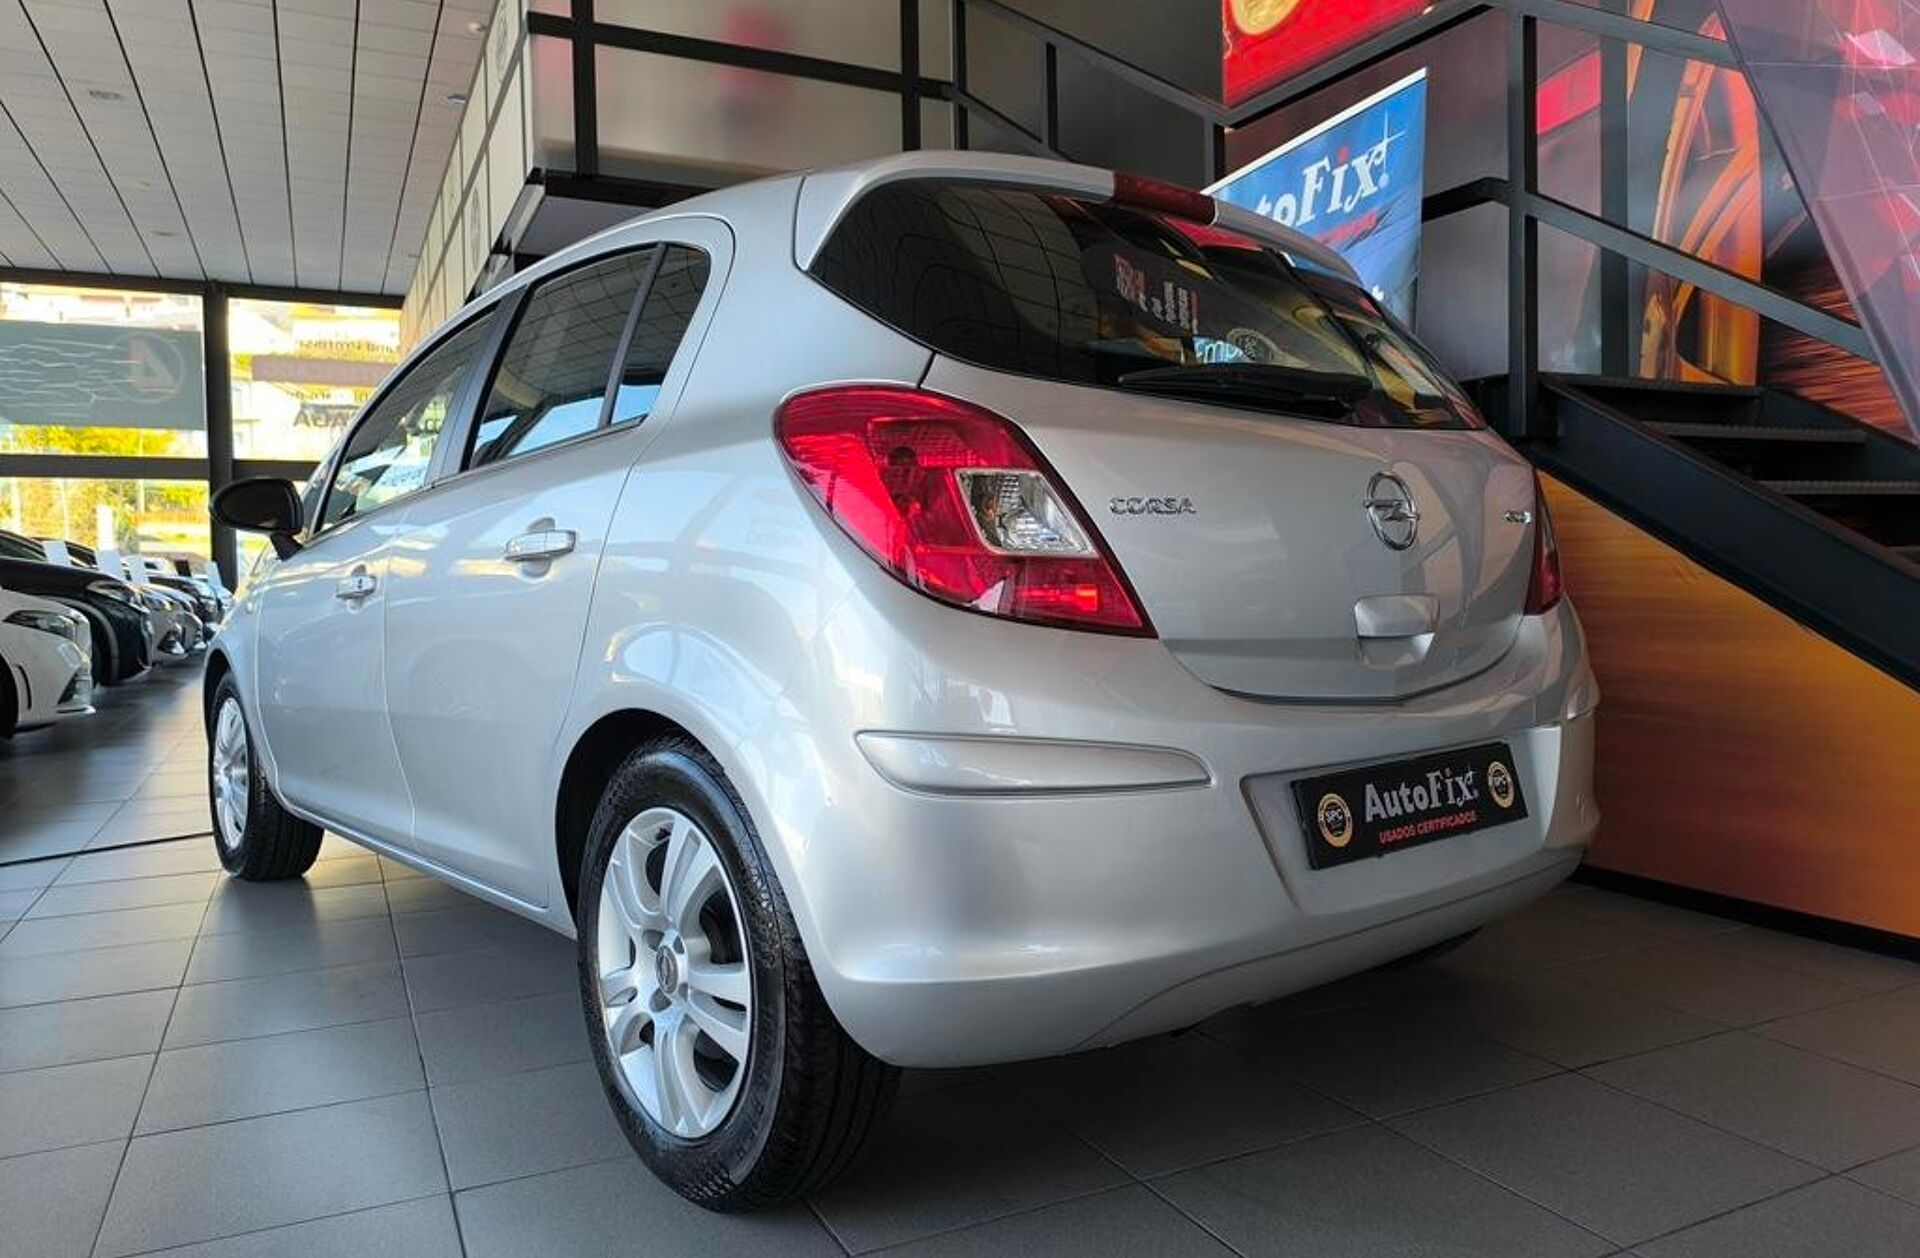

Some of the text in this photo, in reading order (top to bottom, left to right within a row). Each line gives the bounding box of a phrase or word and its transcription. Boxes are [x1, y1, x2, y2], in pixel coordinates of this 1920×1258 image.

[1256, 143, 1388, 228] toFix
[1109, 498, 1197, 515] CORSA
[1365, 766, 1475, 822] AutoFix
[1379, 809, 1477, 843] USADOS CERTIFICADOS
